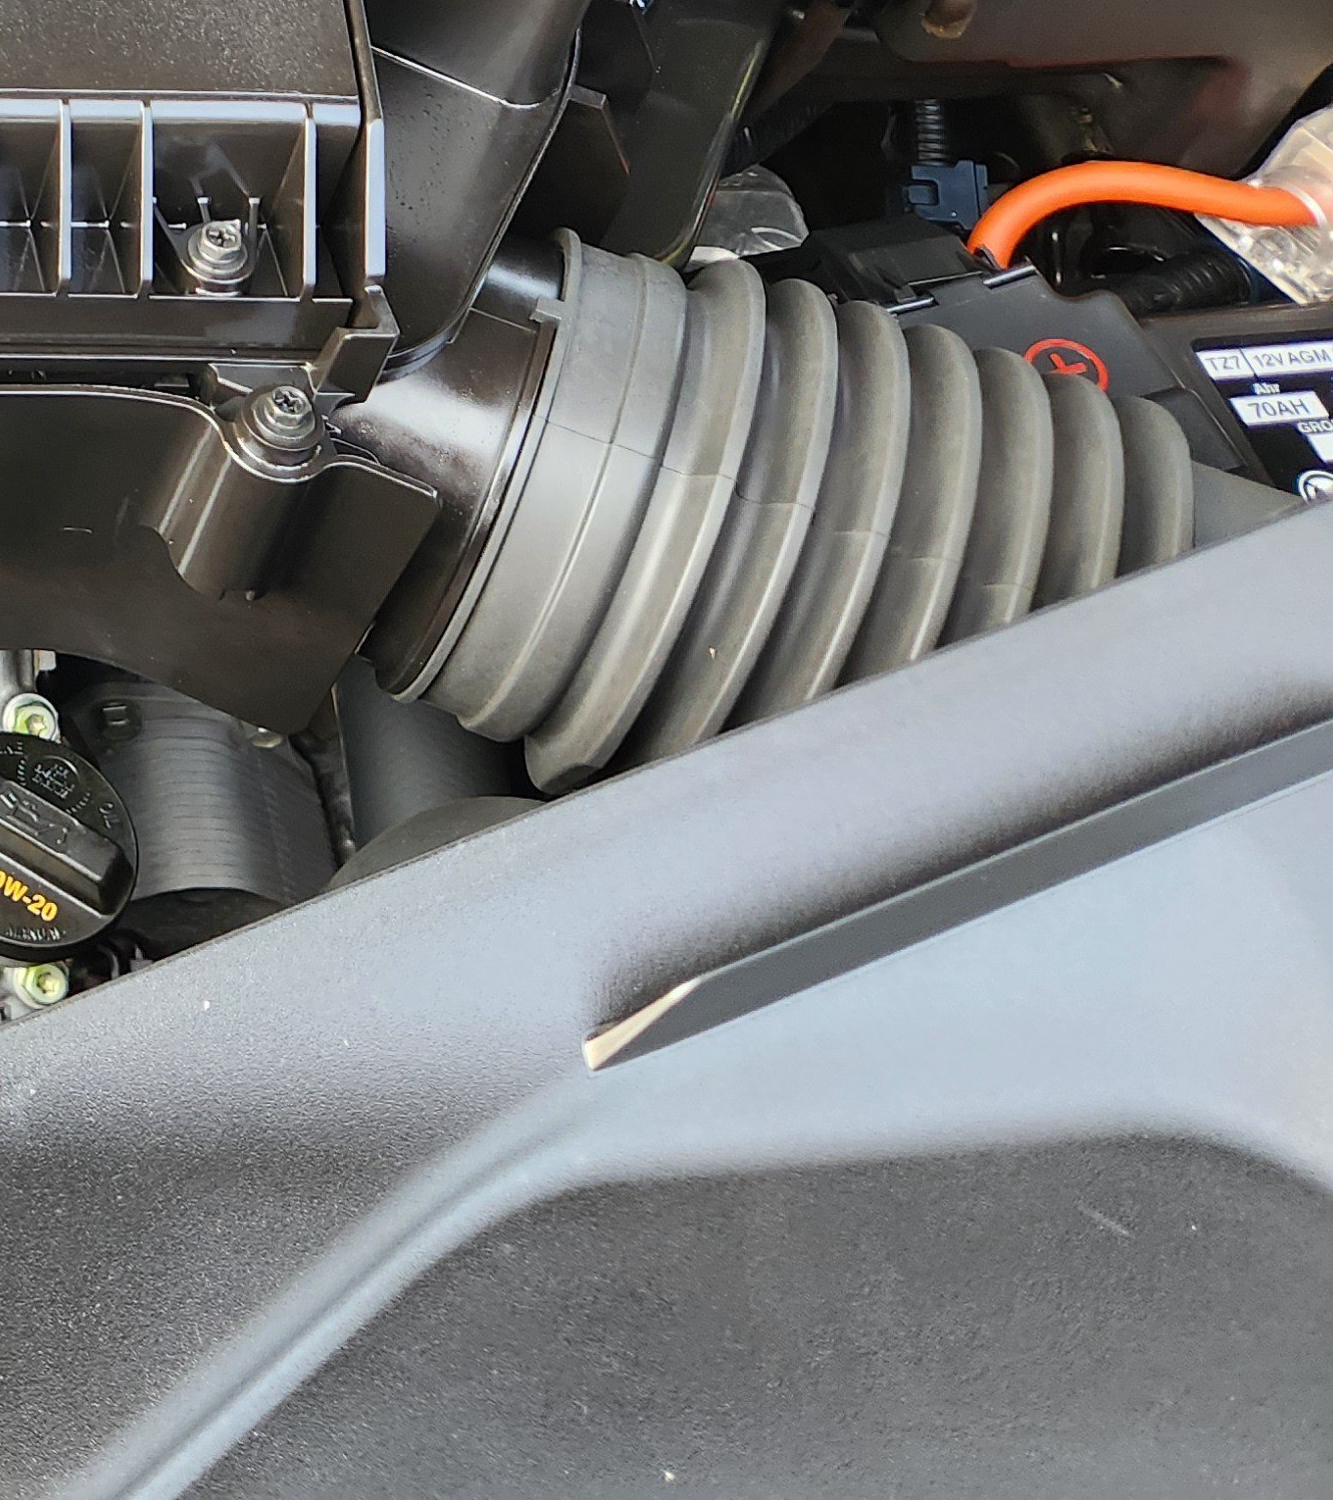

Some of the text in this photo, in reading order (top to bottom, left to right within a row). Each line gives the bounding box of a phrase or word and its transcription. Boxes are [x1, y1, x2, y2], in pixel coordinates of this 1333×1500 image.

[1204, 348, 1333, 372] TZ7 12V AGM
[1246, 397, 1312, 419] 70AH
